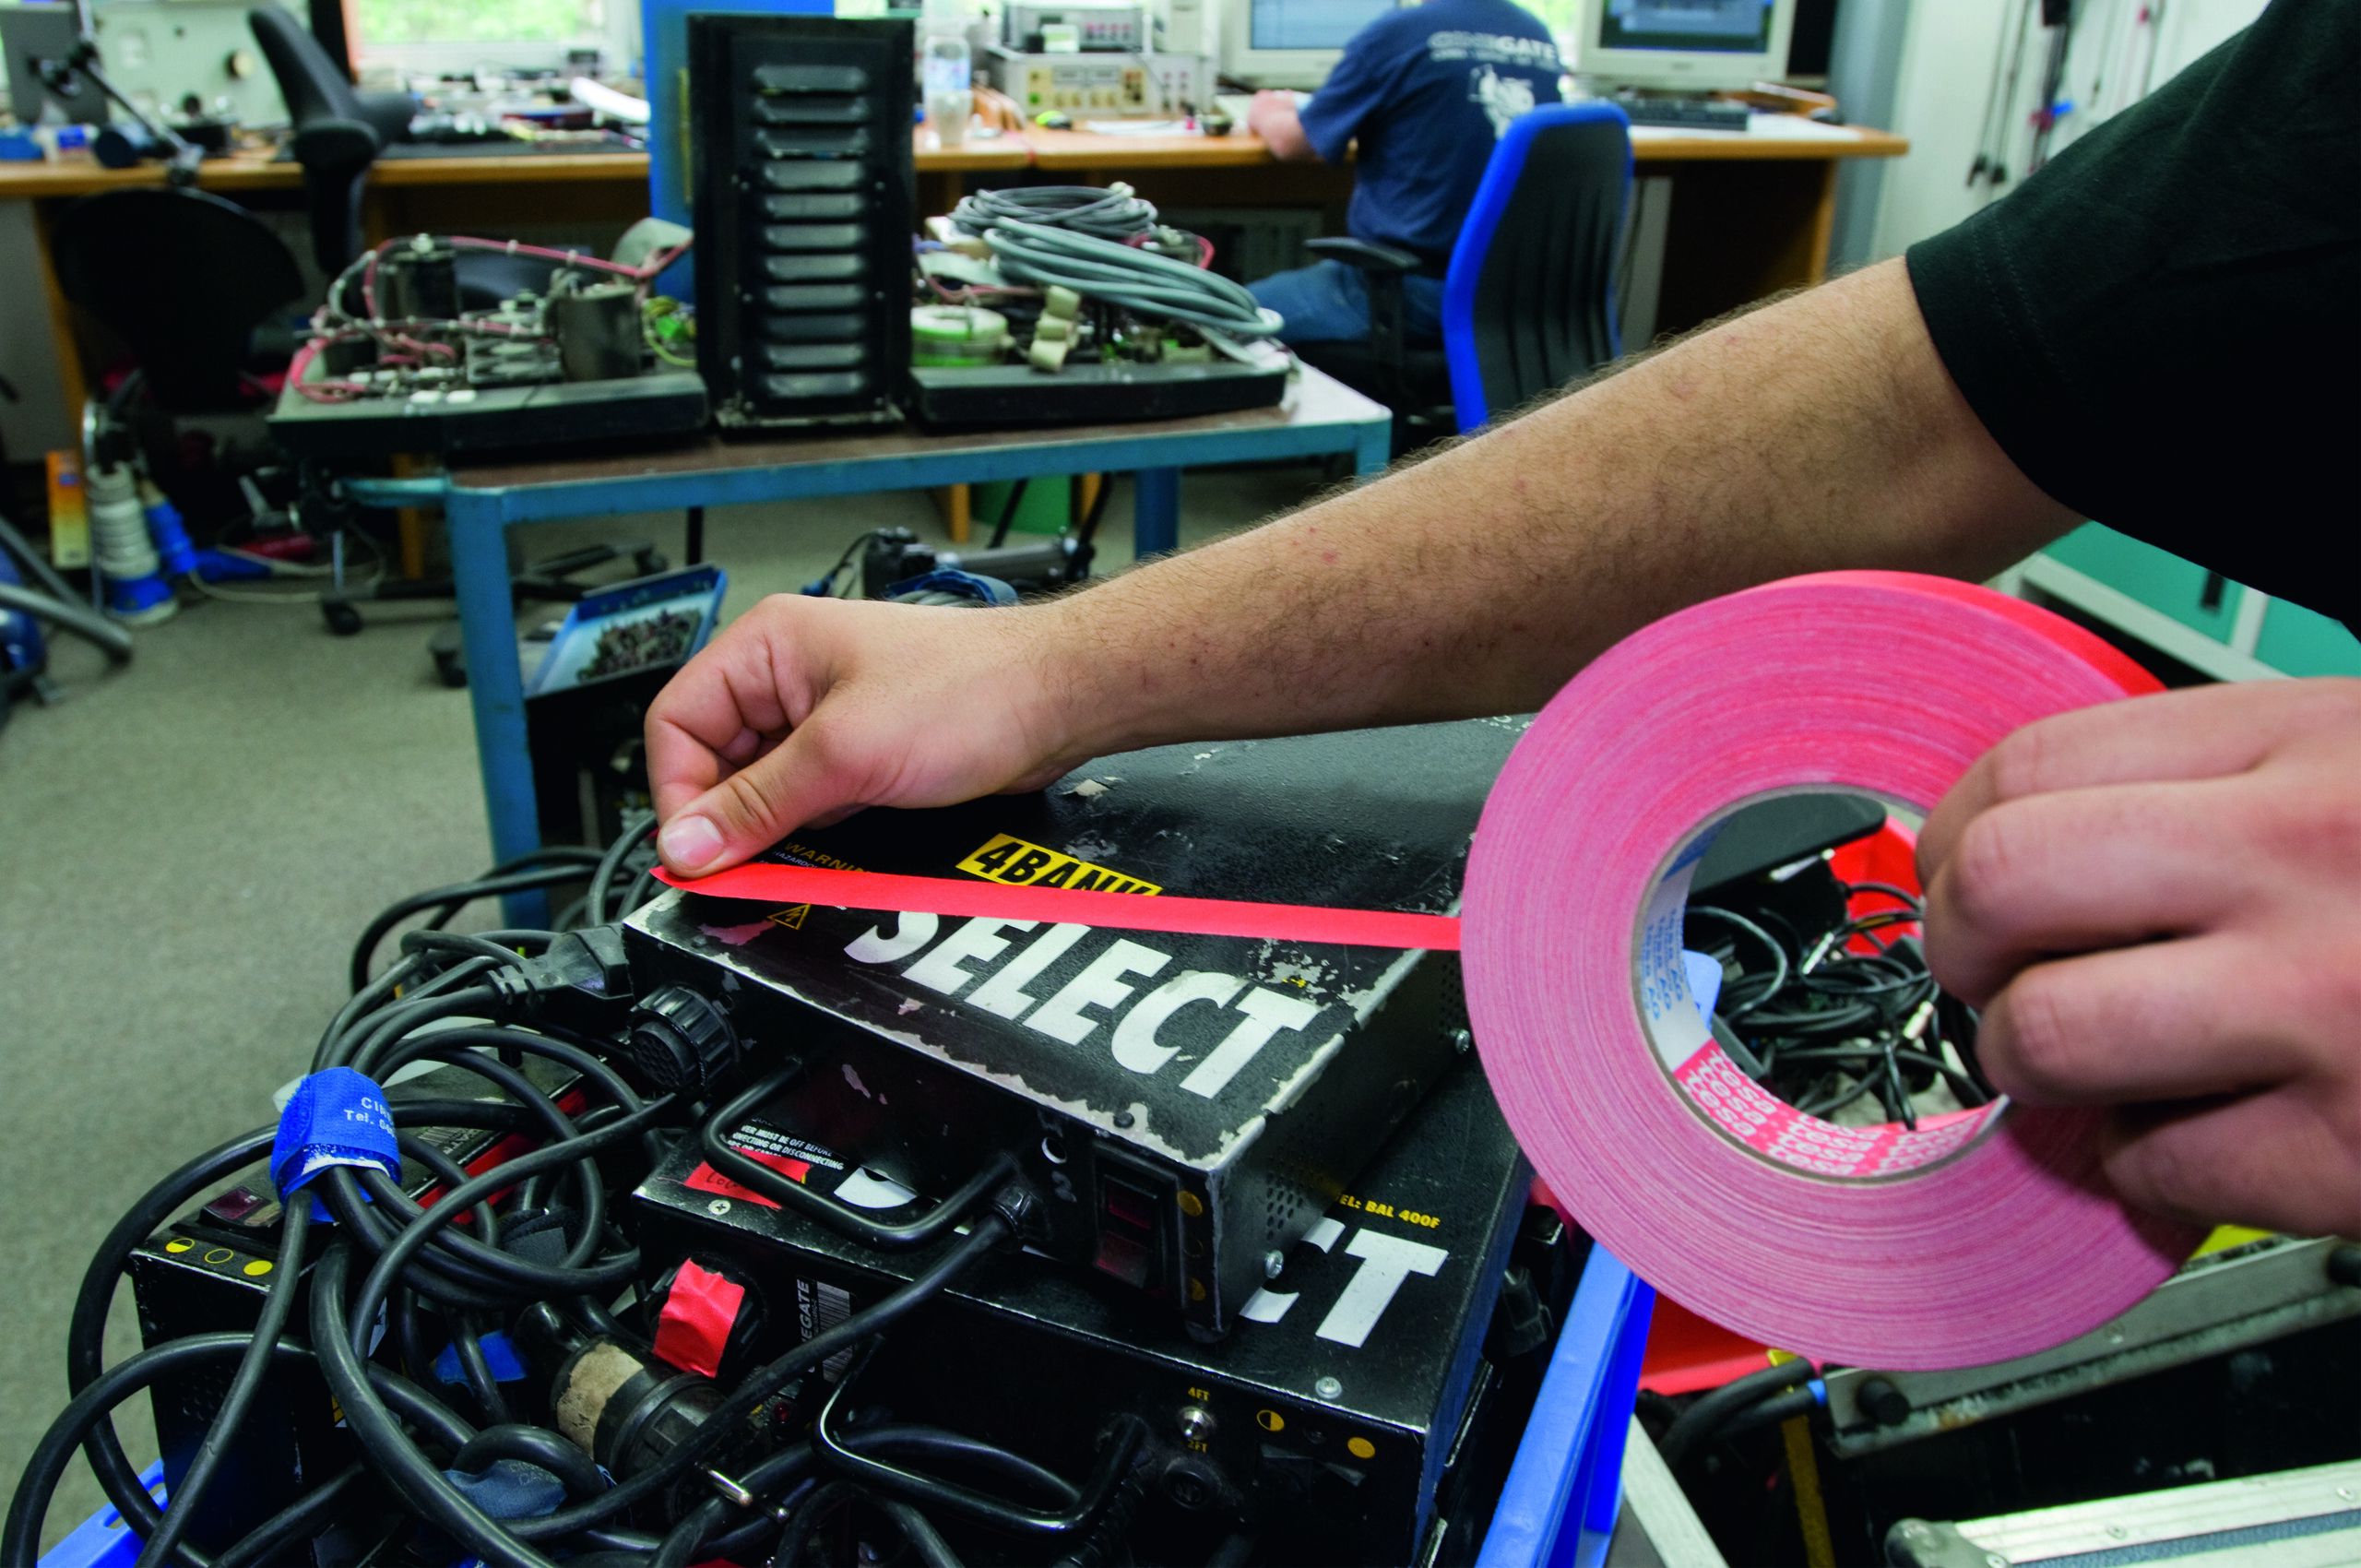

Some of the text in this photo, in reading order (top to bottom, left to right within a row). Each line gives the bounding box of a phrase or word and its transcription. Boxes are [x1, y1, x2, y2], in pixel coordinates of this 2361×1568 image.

[844, 910, 1322, 1099] SELECT
[1698, 1060, 1767, 1125] tesa
[1709, 1050, 1777, 1114] tesa
[344, 1109, 374, 1124] Tel.
[1687, 1069, 1757, 1136] tesa
[789, 1139, 805, 1148] OFF
[1777, 1131, 1866, 1163] tesa
[1787, 1121, 1875, 1152] tesa
[1339, 1194, 1441, 1229] EL: BAL 400F
[796, 1278, 813, 1343] EGATE
[1188, 1386, 1210, 1402] 4FT
